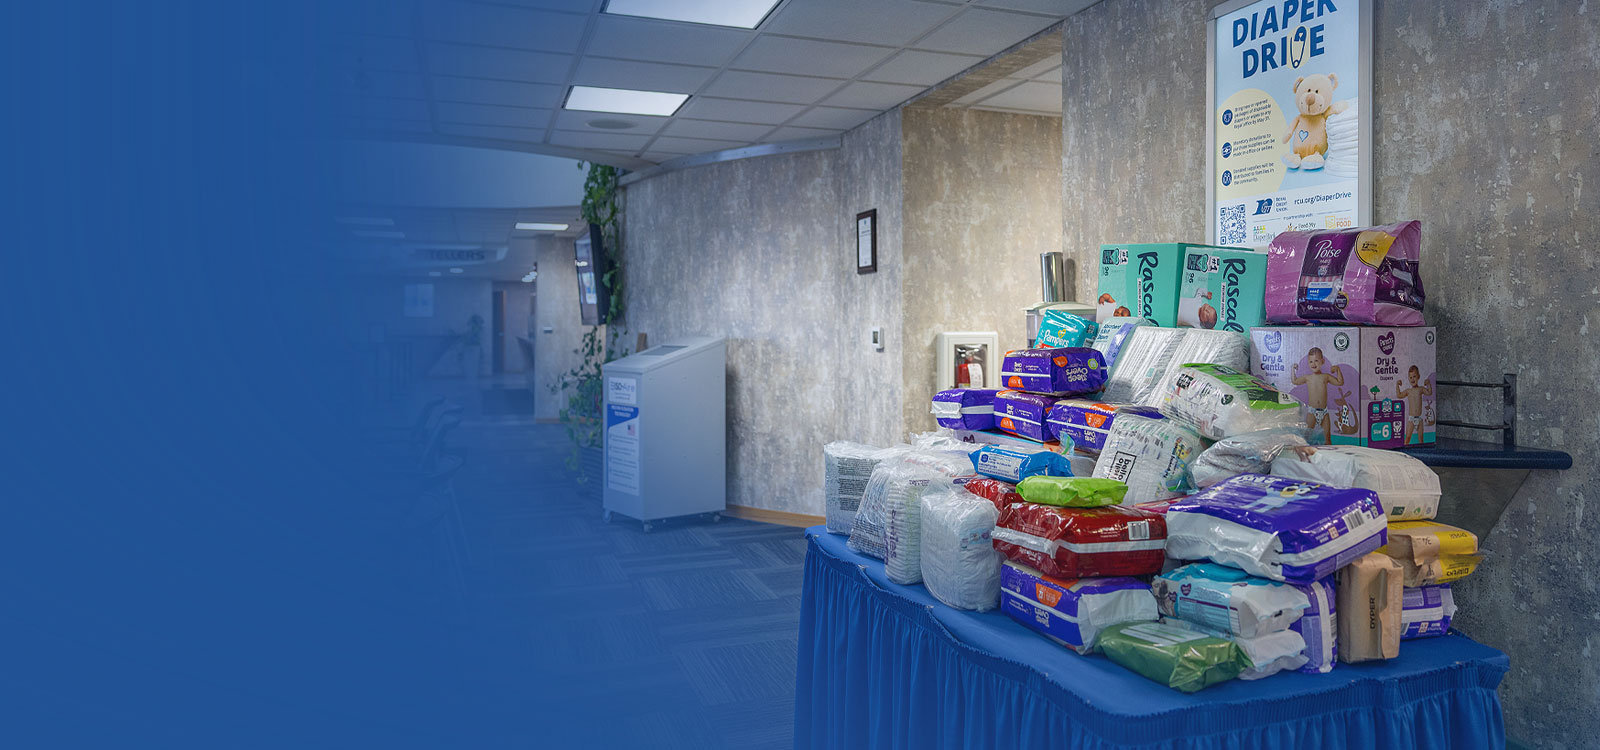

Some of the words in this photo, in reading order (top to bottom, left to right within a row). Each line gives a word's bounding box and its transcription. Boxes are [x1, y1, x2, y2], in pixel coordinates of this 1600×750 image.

[1233, 0, 1337, 48] DIAPER
[1294, 192, 1352, 204] rcu.org/DiaperDrive
[1314, 240, 1341, 260] Poise
[1223, 258, 1246, 333] Rascal
[1044, 330, 1069, 348] Pampers
[1262, 355, 1276, 364] Dry
[1377, 357, 1389, 366] Dry
[1375, 366, 1398, 374] Gentle
[1382, 425, 1389, 438] 6
